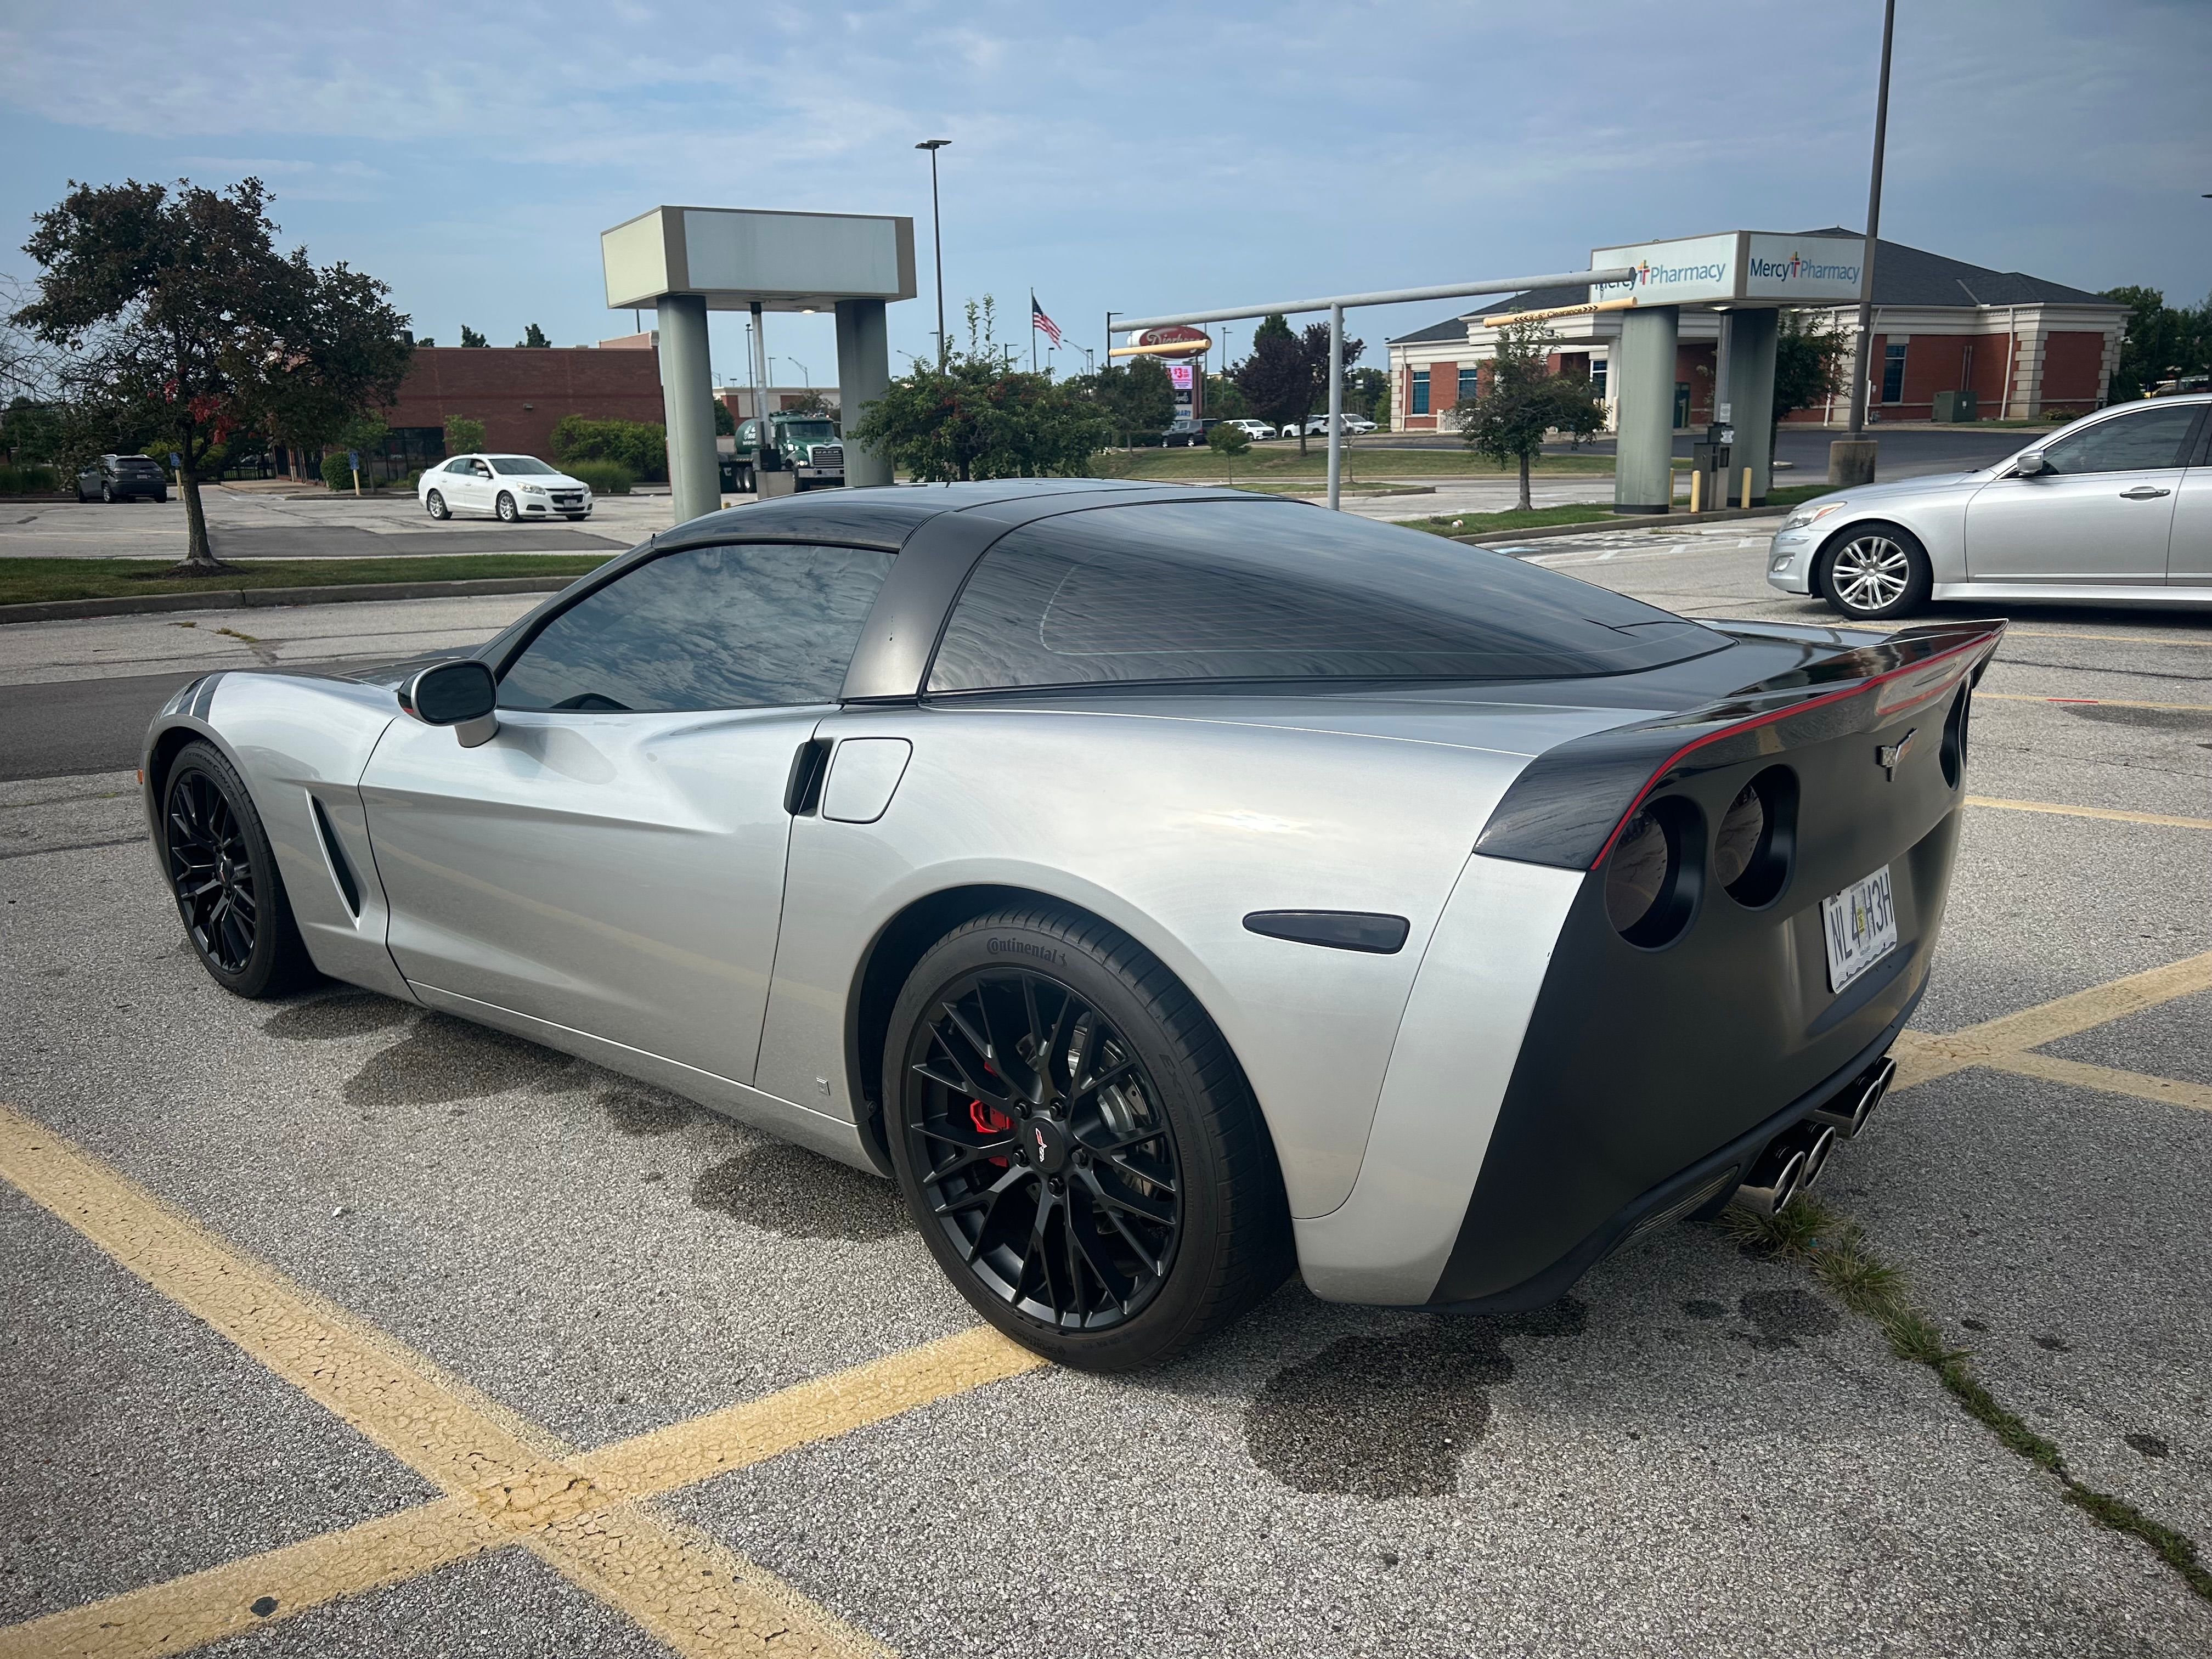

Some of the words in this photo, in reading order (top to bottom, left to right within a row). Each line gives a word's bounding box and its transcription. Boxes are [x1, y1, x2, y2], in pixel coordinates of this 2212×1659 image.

[1650, 263, 1726, 284] Pharmacy
[1750, 258, 1790, 282] Mercy
[1800, 259, 1860, 284] Pharmacy
[1548, 308, 1582, 318] Clearance
[987, 937, 1058, 963] Continental
